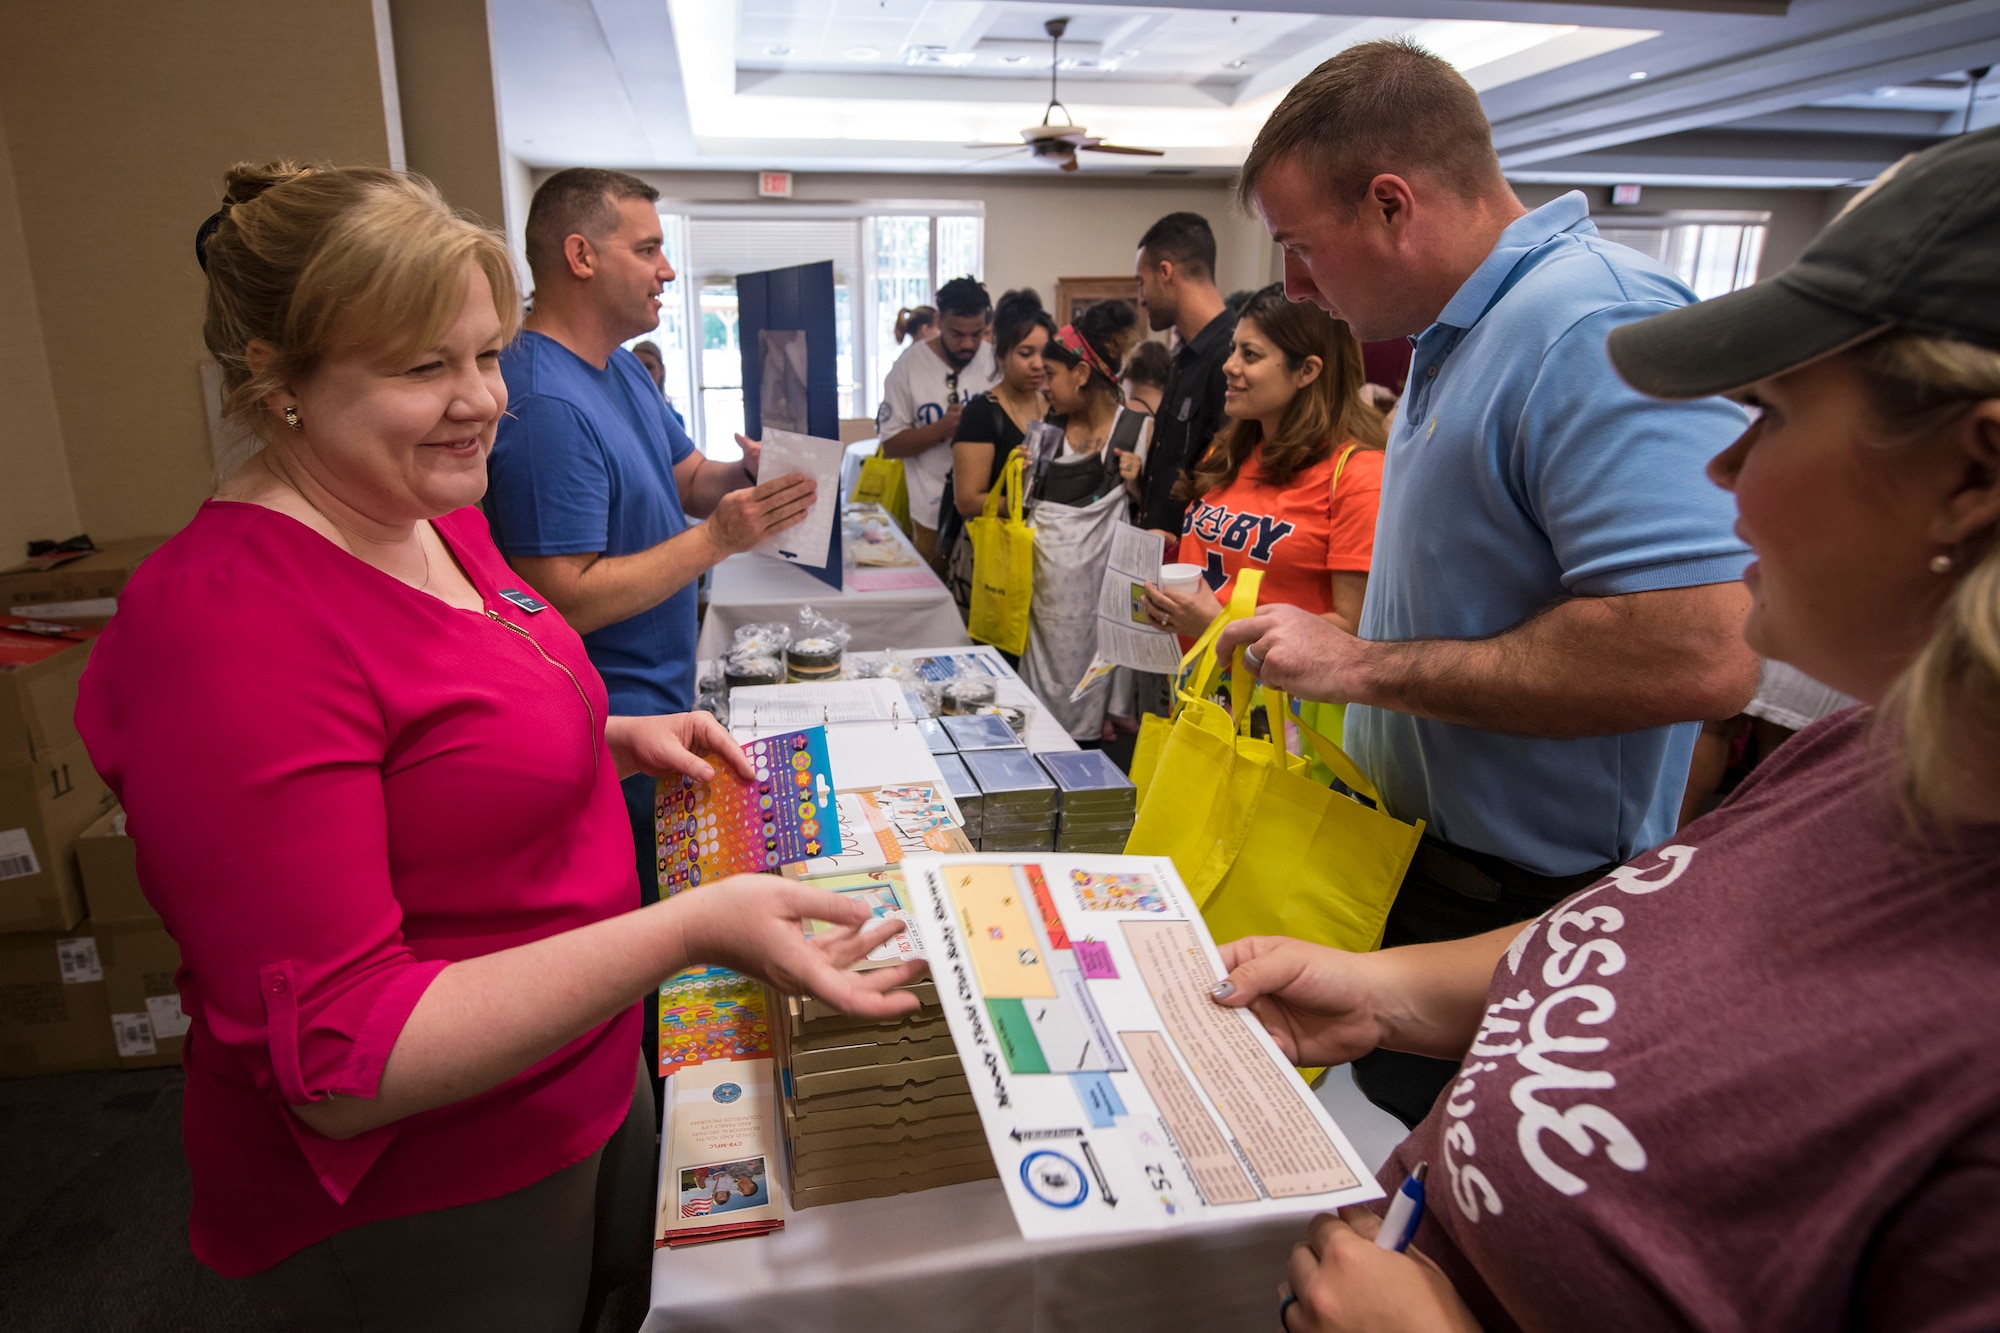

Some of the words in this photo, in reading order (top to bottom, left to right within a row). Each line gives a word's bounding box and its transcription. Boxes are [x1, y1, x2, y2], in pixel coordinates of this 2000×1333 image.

[764, 173, 787, 193] EXIT
[723, 1114, 762, 1122] COUNSELOR
[721, 1126, 761, 1134] BEHAVIORAL
[708, 1141, 743, 1149] CYB-MFLC
[1145, 1165, 1171, 1190] 52
